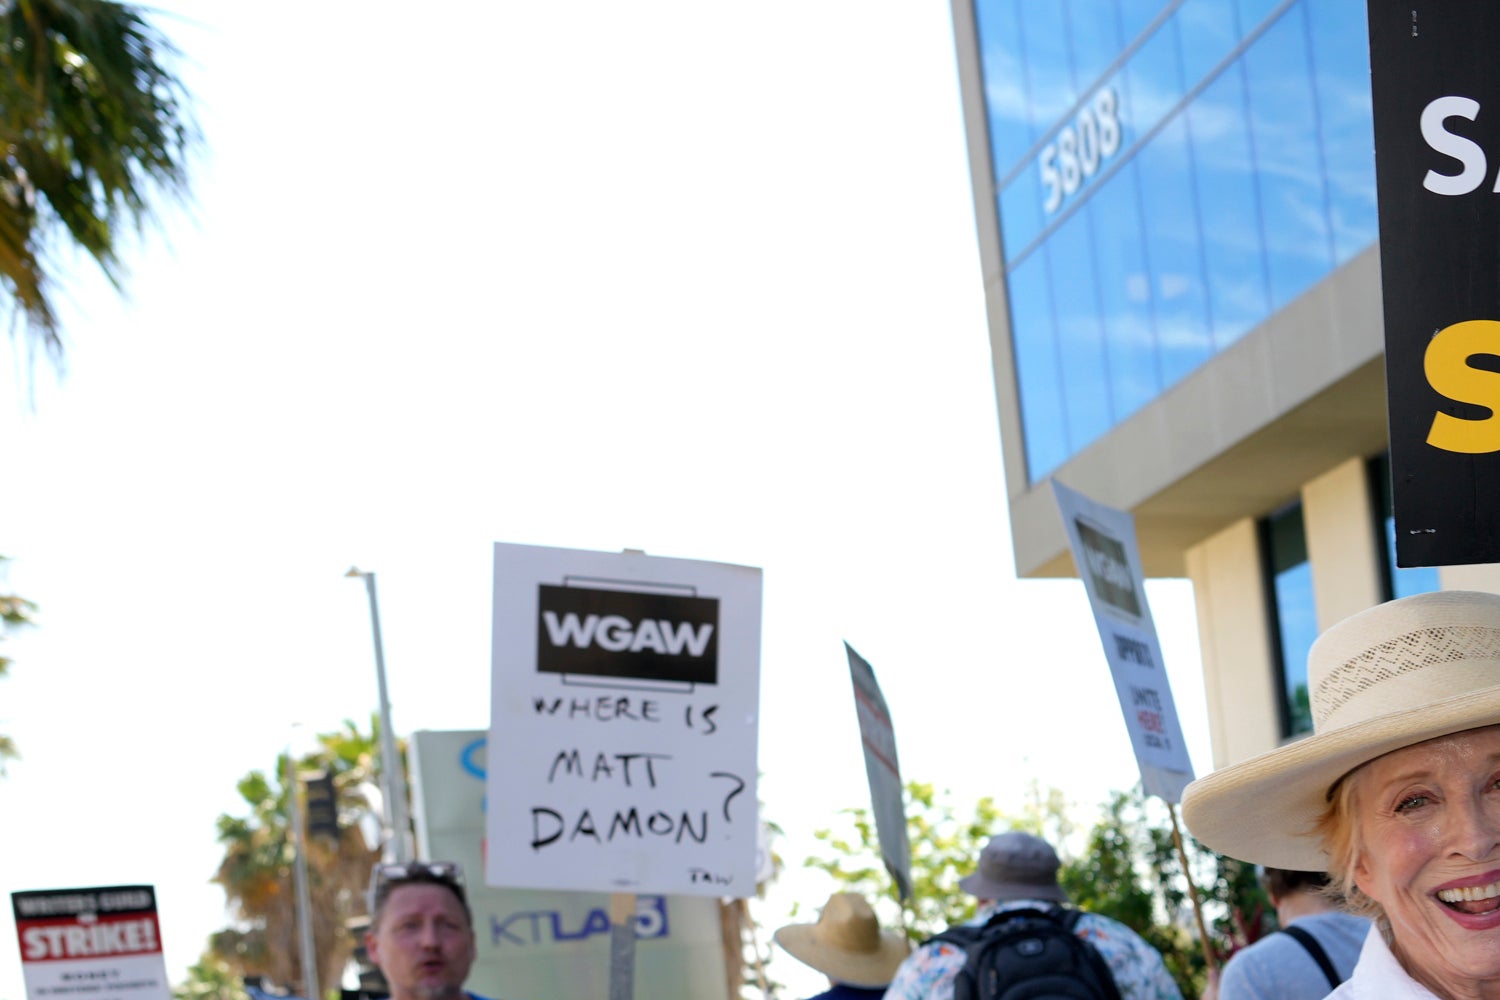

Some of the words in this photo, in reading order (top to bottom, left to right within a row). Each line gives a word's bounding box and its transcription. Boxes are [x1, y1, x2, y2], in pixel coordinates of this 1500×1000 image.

[1038, 87, 1121, 214] 5808
[543, 610, 714, 658] WGAW
[531, 695, 662, 723] WHERE
[684, 703, 720, 736] IS
[548, 748, 673, 788] MATT
[22, 917, 159, 960] STRIKE!
[489, 908, 613, 948] KTLA
